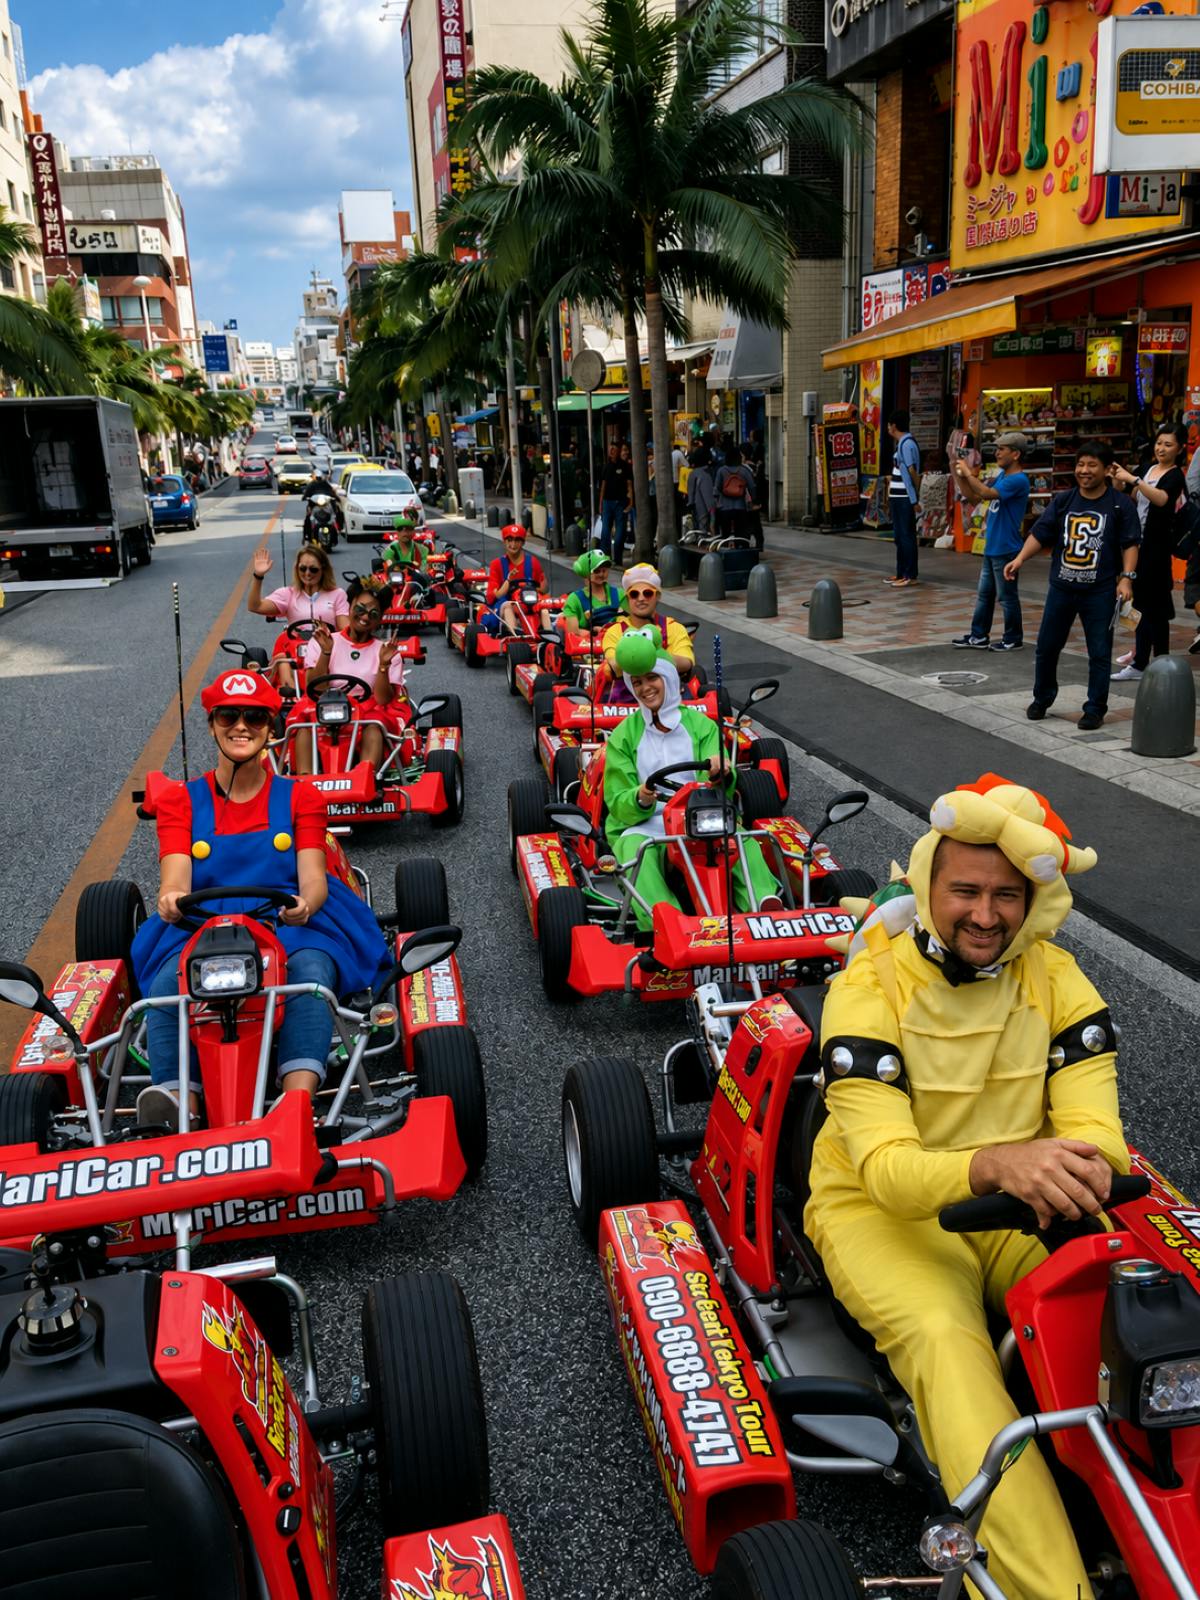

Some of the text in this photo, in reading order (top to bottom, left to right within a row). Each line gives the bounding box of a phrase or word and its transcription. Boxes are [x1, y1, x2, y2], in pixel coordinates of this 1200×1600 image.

[1120, 175, 1177, 213] Mi-ja
[226, 677, 254, 691] M
[747, 913, 856, 939] MariCa
[0, 1138, 270, 1206] ariCar.com
[142, 1187, 364, 1238] MriCar.com
[640, 1275, 742, 1466] 090-6888-4747
[733, 1400, 773, 1457] Tour
